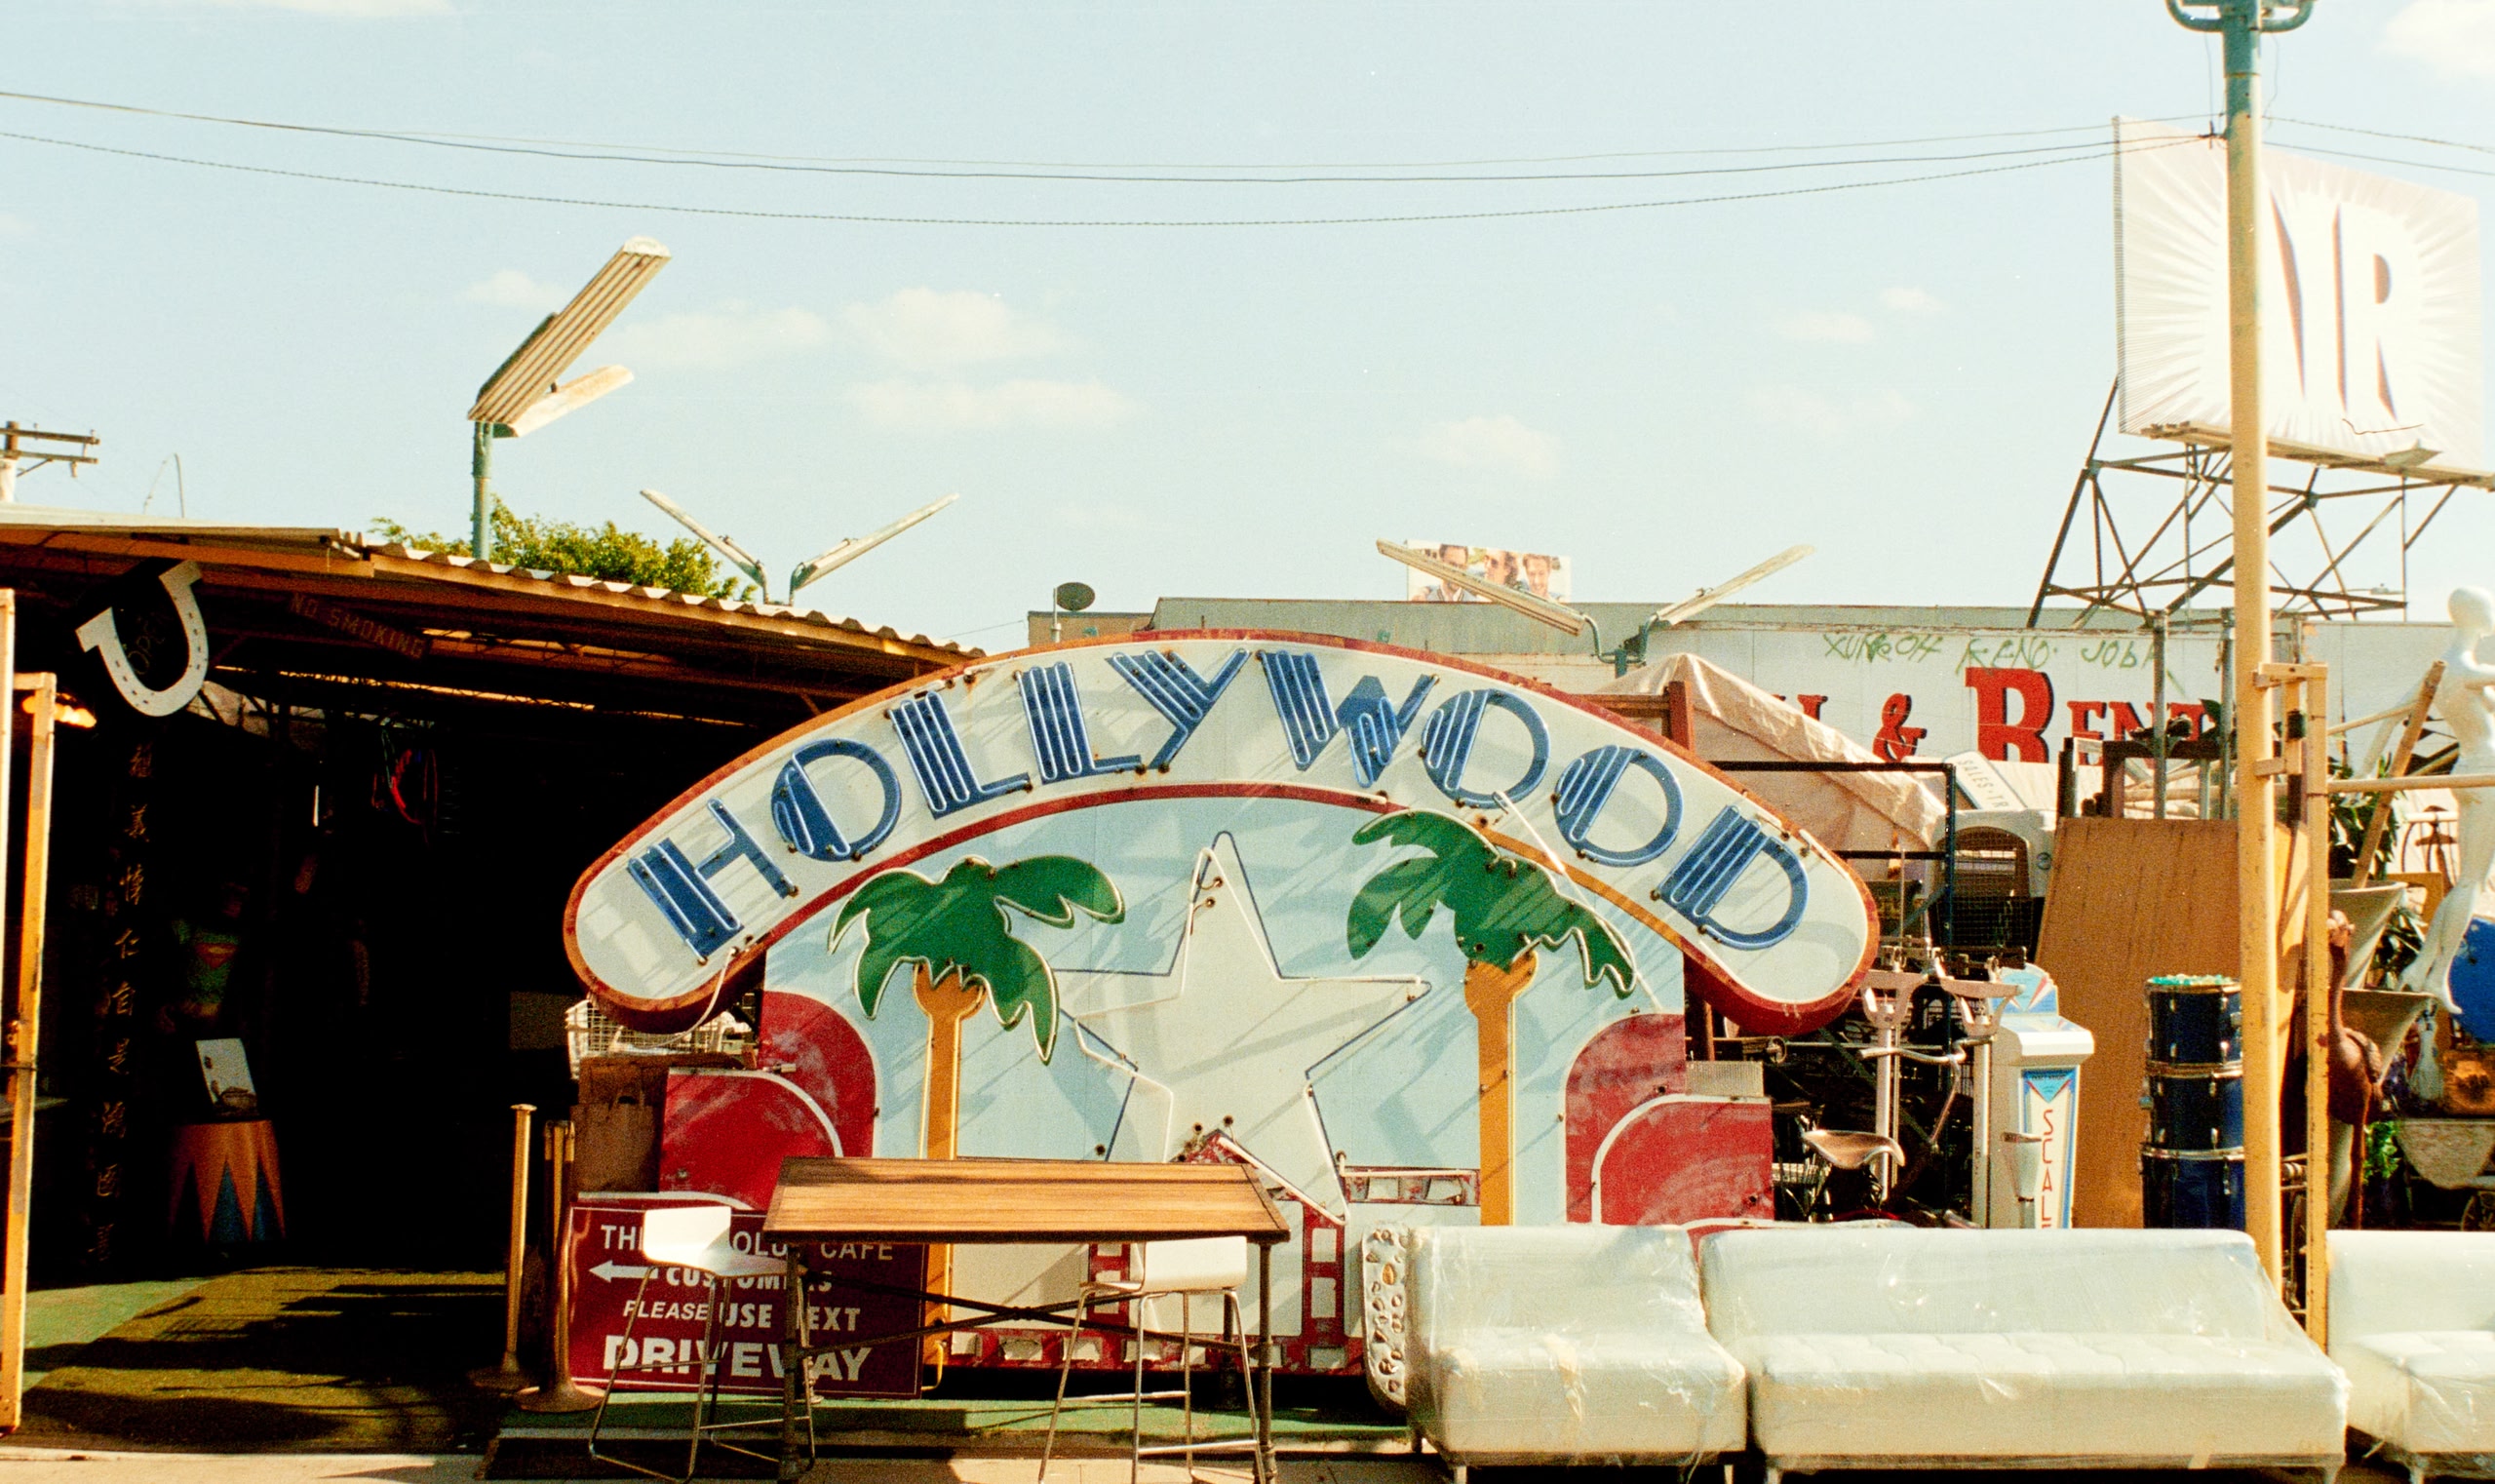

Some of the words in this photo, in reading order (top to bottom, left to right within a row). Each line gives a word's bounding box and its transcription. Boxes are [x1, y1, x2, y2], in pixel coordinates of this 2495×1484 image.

[292, 592, 319, 619] NO
[328, 606, 426, 660] SMOKING
[627, 649, 1810, 963] HOLLYWOOD
[2041, 1109, 2054, 1229] SCAL
[601, 1225, 643, 1250] TH
[820, 1242, 894, 1261] CAFE
[623, 1300, 711, 1321] PLEASE
[720, 1302, 773, 1328] USE
[797, 1306, 861, 1332] EXT
